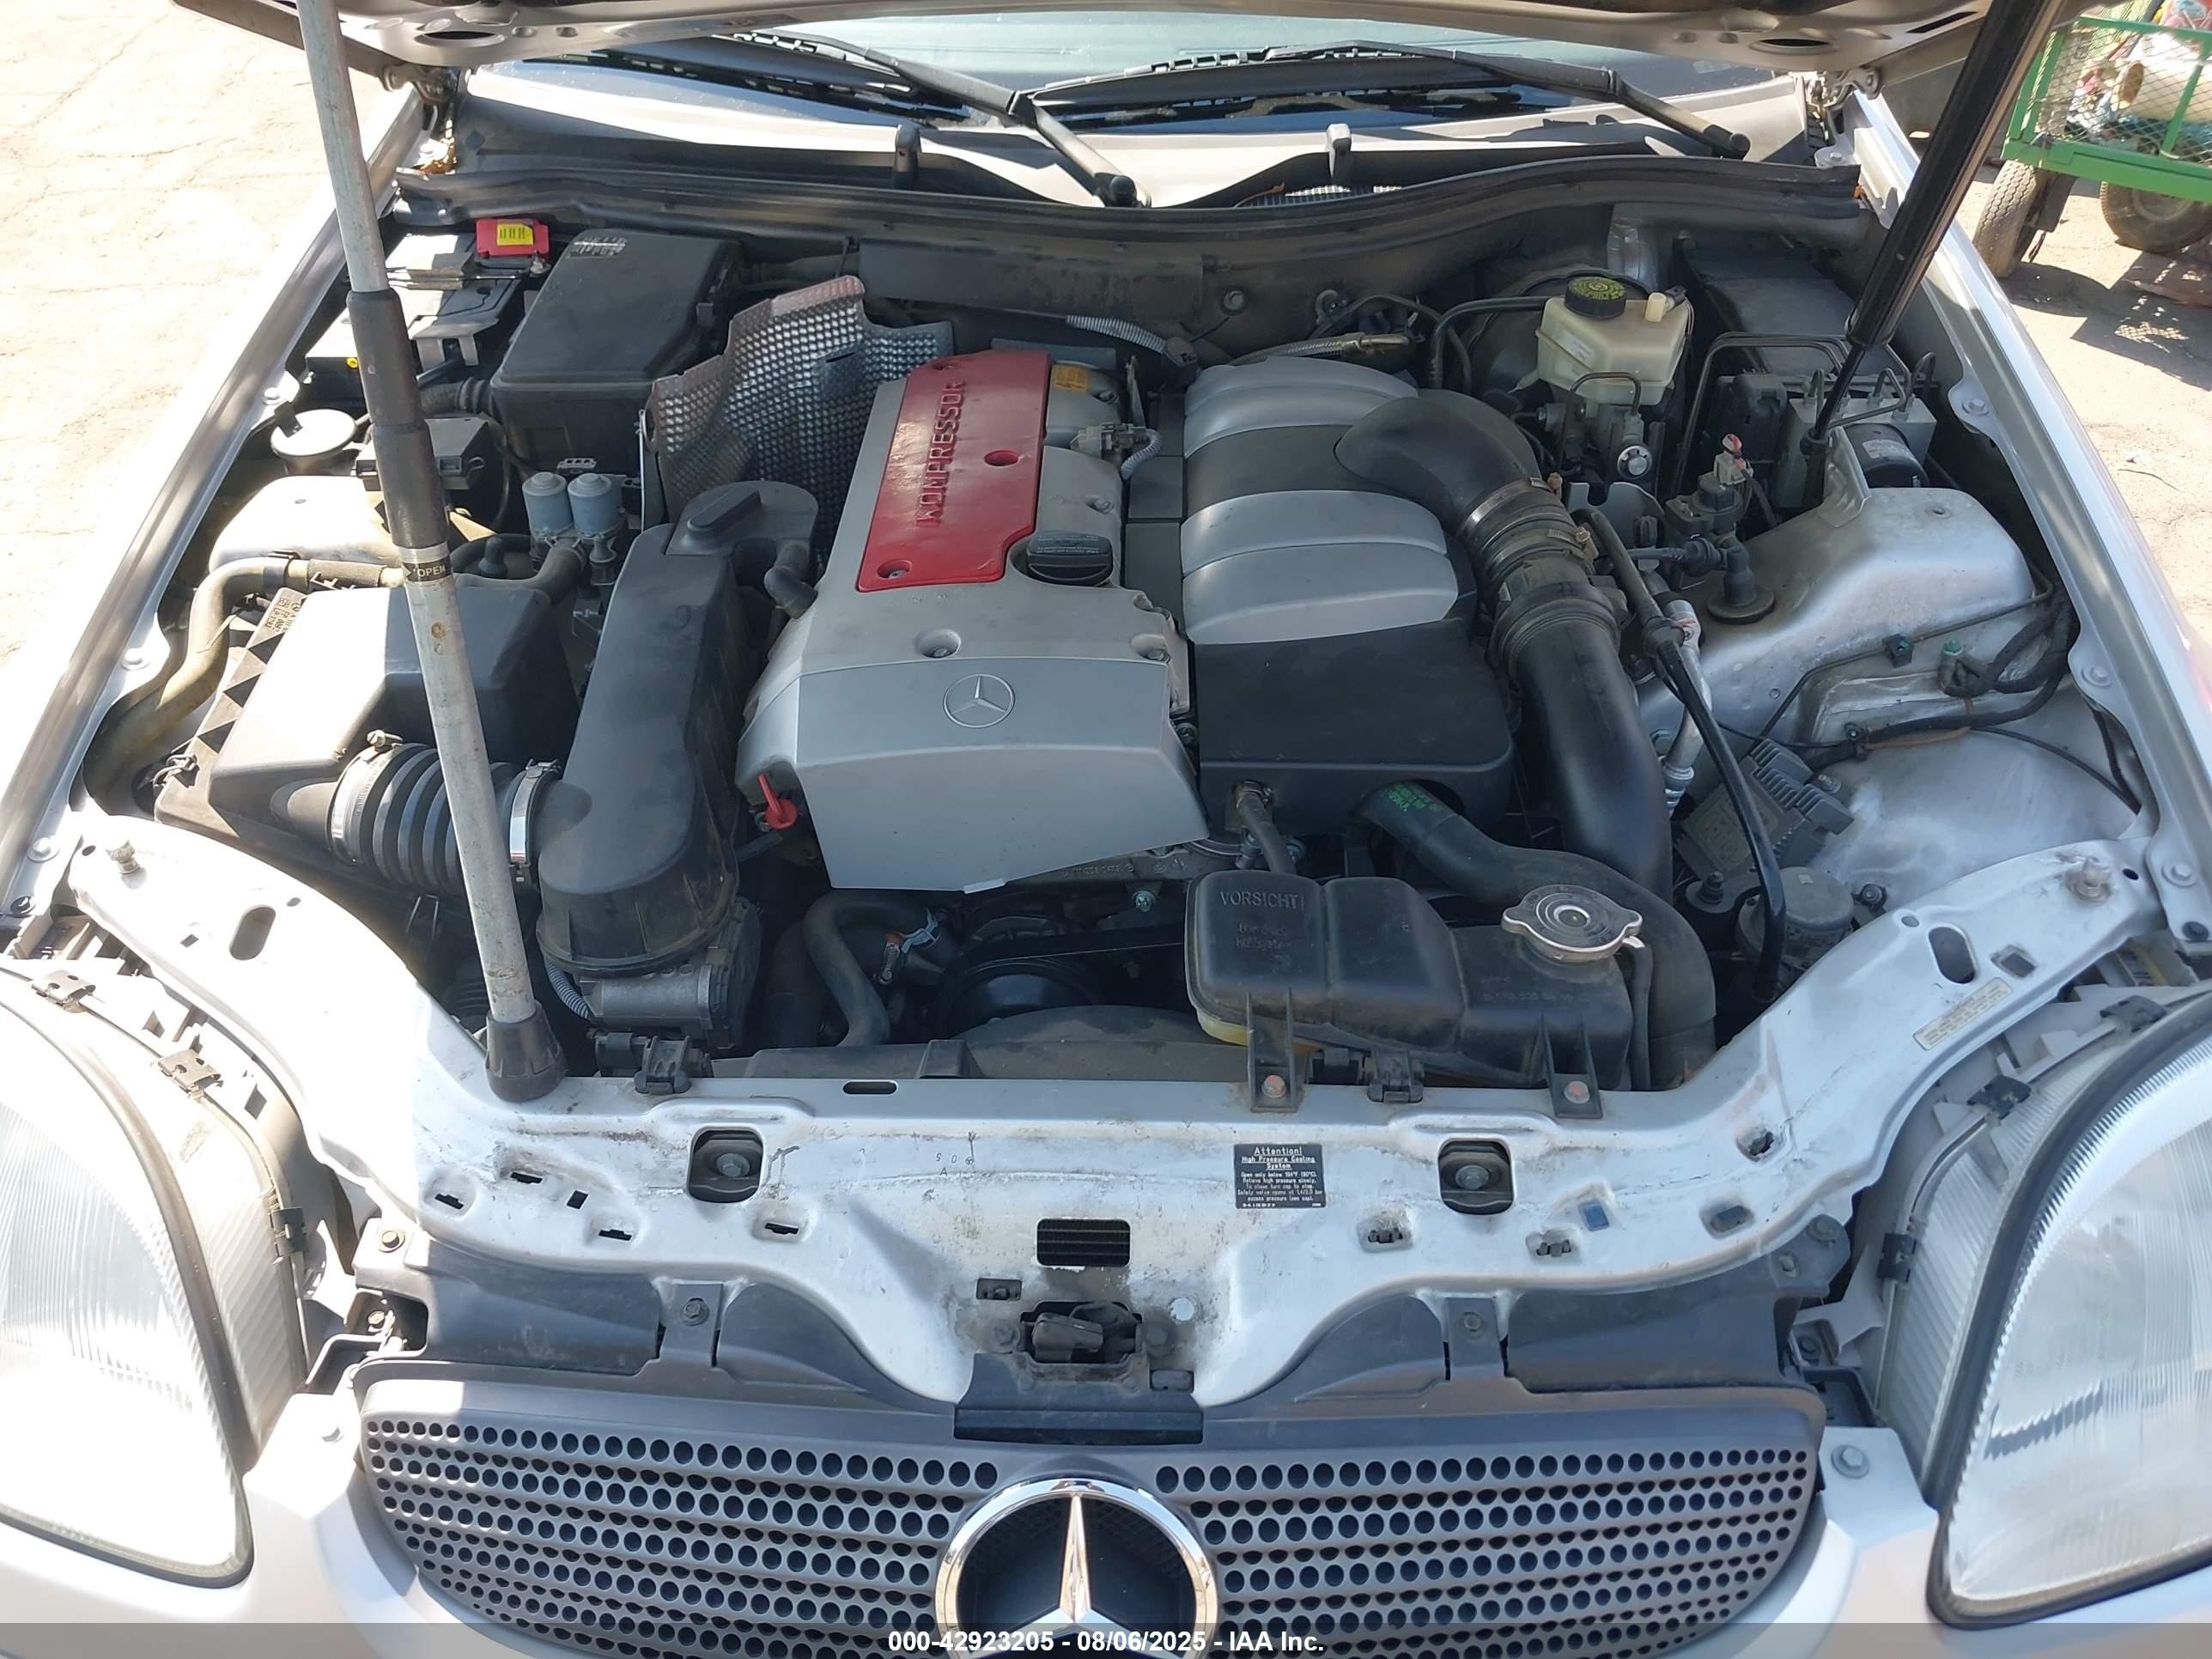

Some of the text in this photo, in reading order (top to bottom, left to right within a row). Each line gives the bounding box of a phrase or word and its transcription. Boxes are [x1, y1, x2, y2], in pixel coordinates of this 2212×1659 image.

[916, 381, 966, 527] KOMPRESSOR
[417, 564, 446, 577] OPEN
[1254, 1146, 1303, 1156] Attention!
